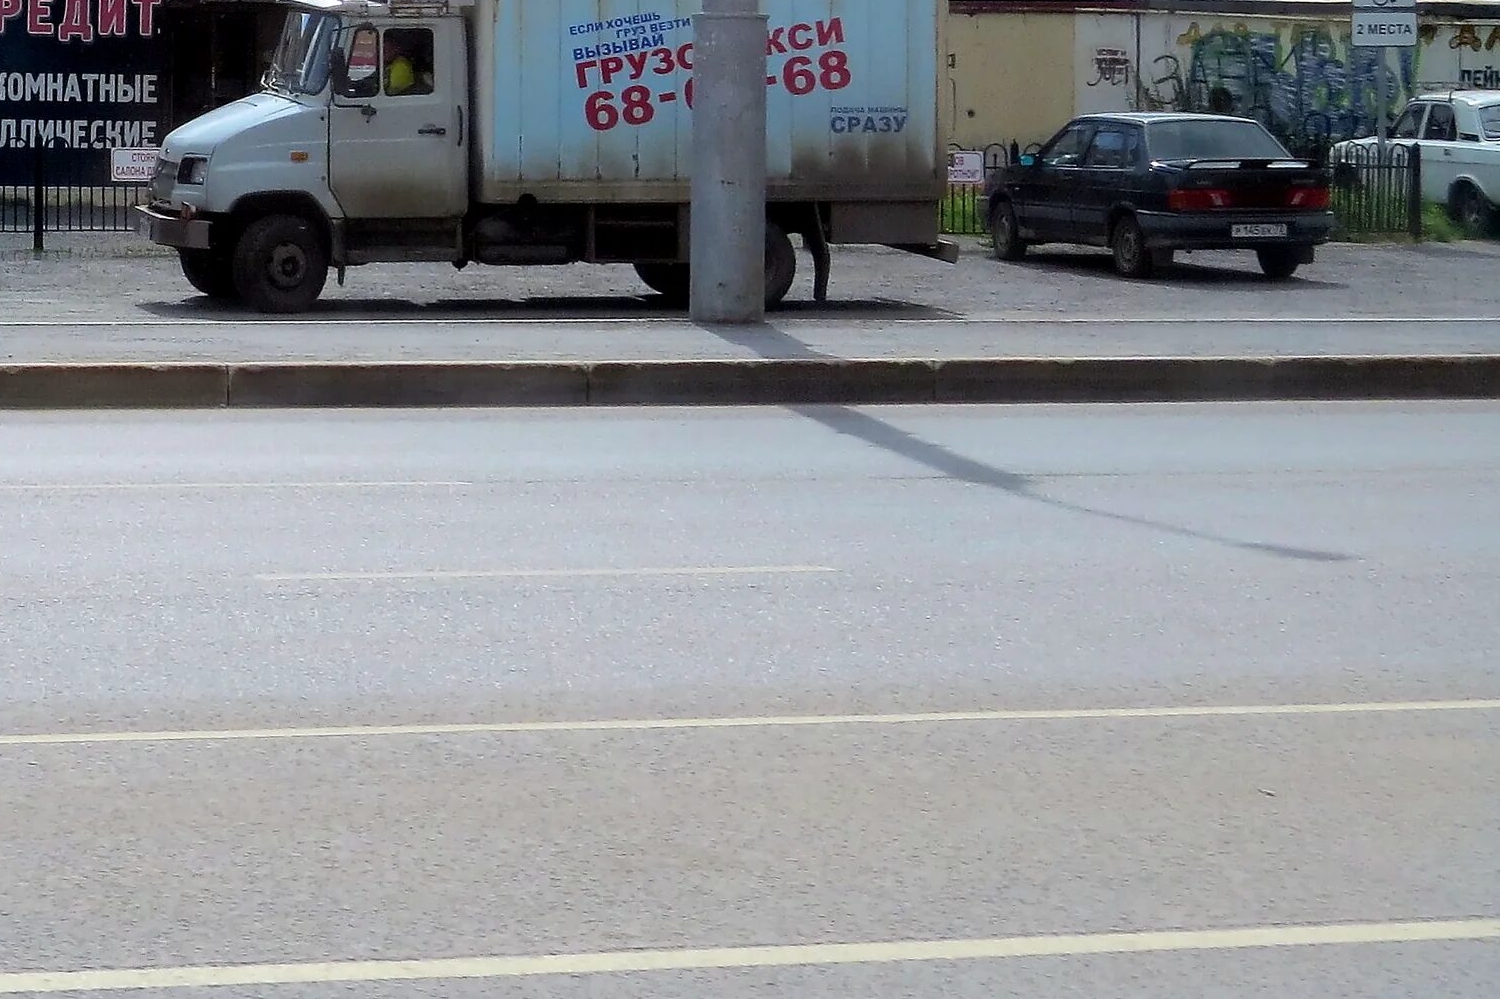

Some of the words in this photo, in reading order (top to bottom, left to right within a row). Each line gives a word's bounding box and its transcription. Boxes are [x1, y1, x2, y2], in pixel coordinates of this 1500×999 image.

[569, 22, 604, 36] ЕСЛИ
[606, 12, 661, 29] ХОЧЕШЬ
[615, 27, 647, 39] ГРУЗ
[650, 17, 691, 33] ВЕЗТИ
[1356, 23, 1364, 35] 2
[1367, 23, 1413, 35] МЕСТА
[572, 33, 665, 61] ВЫЗЫВАЙ
[830, 115, 908, 133] СРАЗУ
